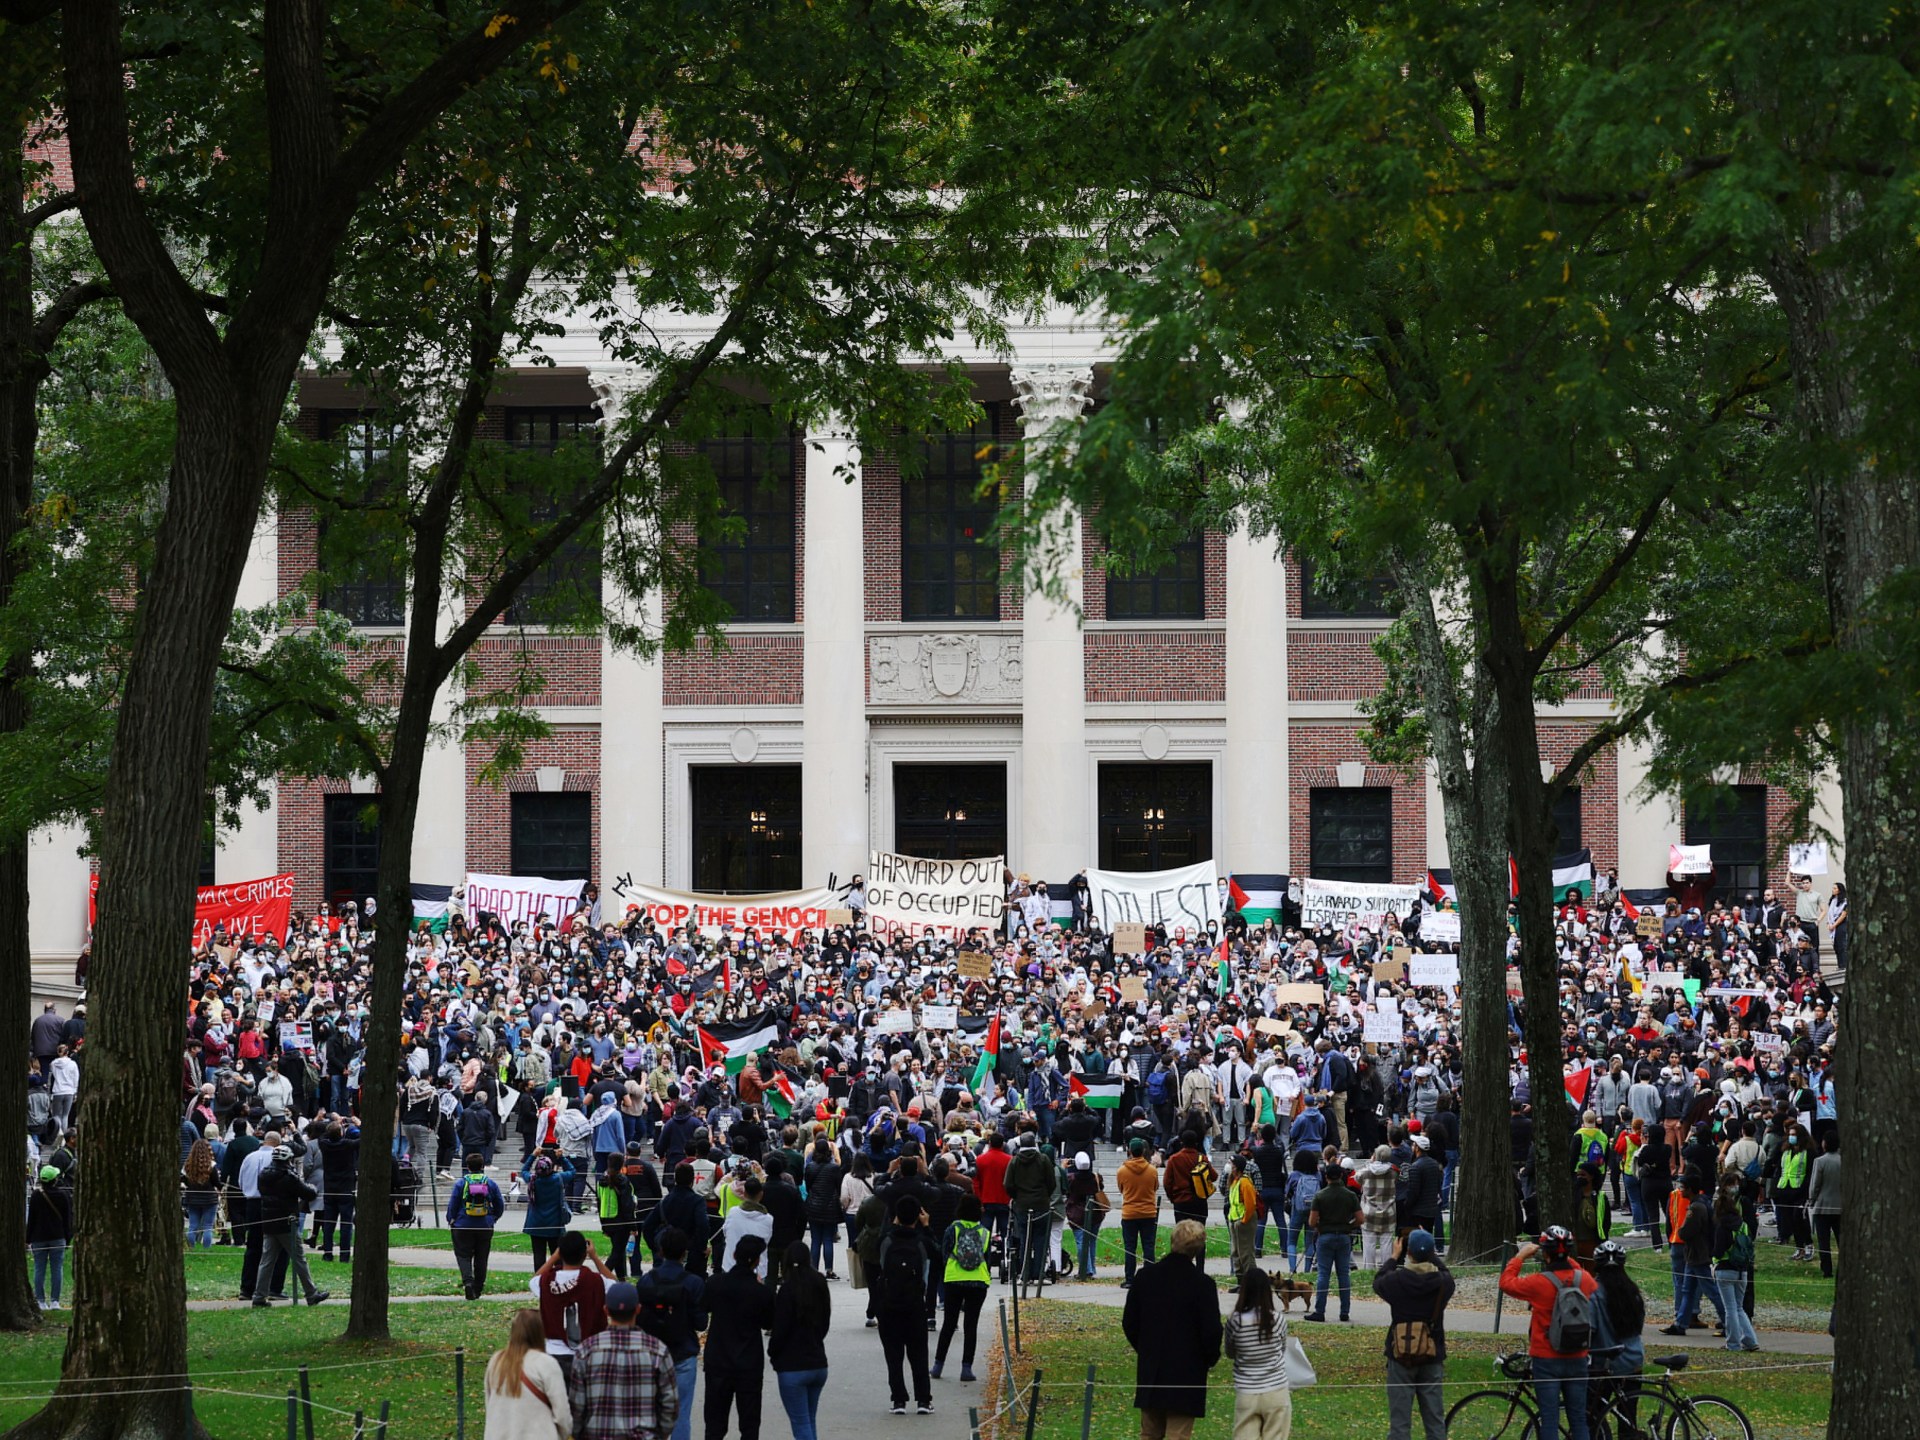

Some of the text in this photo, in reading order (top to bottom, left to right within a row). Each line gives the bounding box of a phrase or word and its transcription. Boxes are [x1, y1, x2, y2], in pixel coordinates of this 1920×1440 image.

[869, 852, 1003, 885] HARVARD OUT
[234, 876, 293, 904] CRIMES
[868, 888, 1004, 919] OF OCCUPIED
[1307, 894, 1414, 914] HARVARD SUPPORTS
[697, 905, 737, 926] THE
[1102, 882, 1212, 936] DIVEST
[1411, 967, 1452, 976] GENOCIDE
